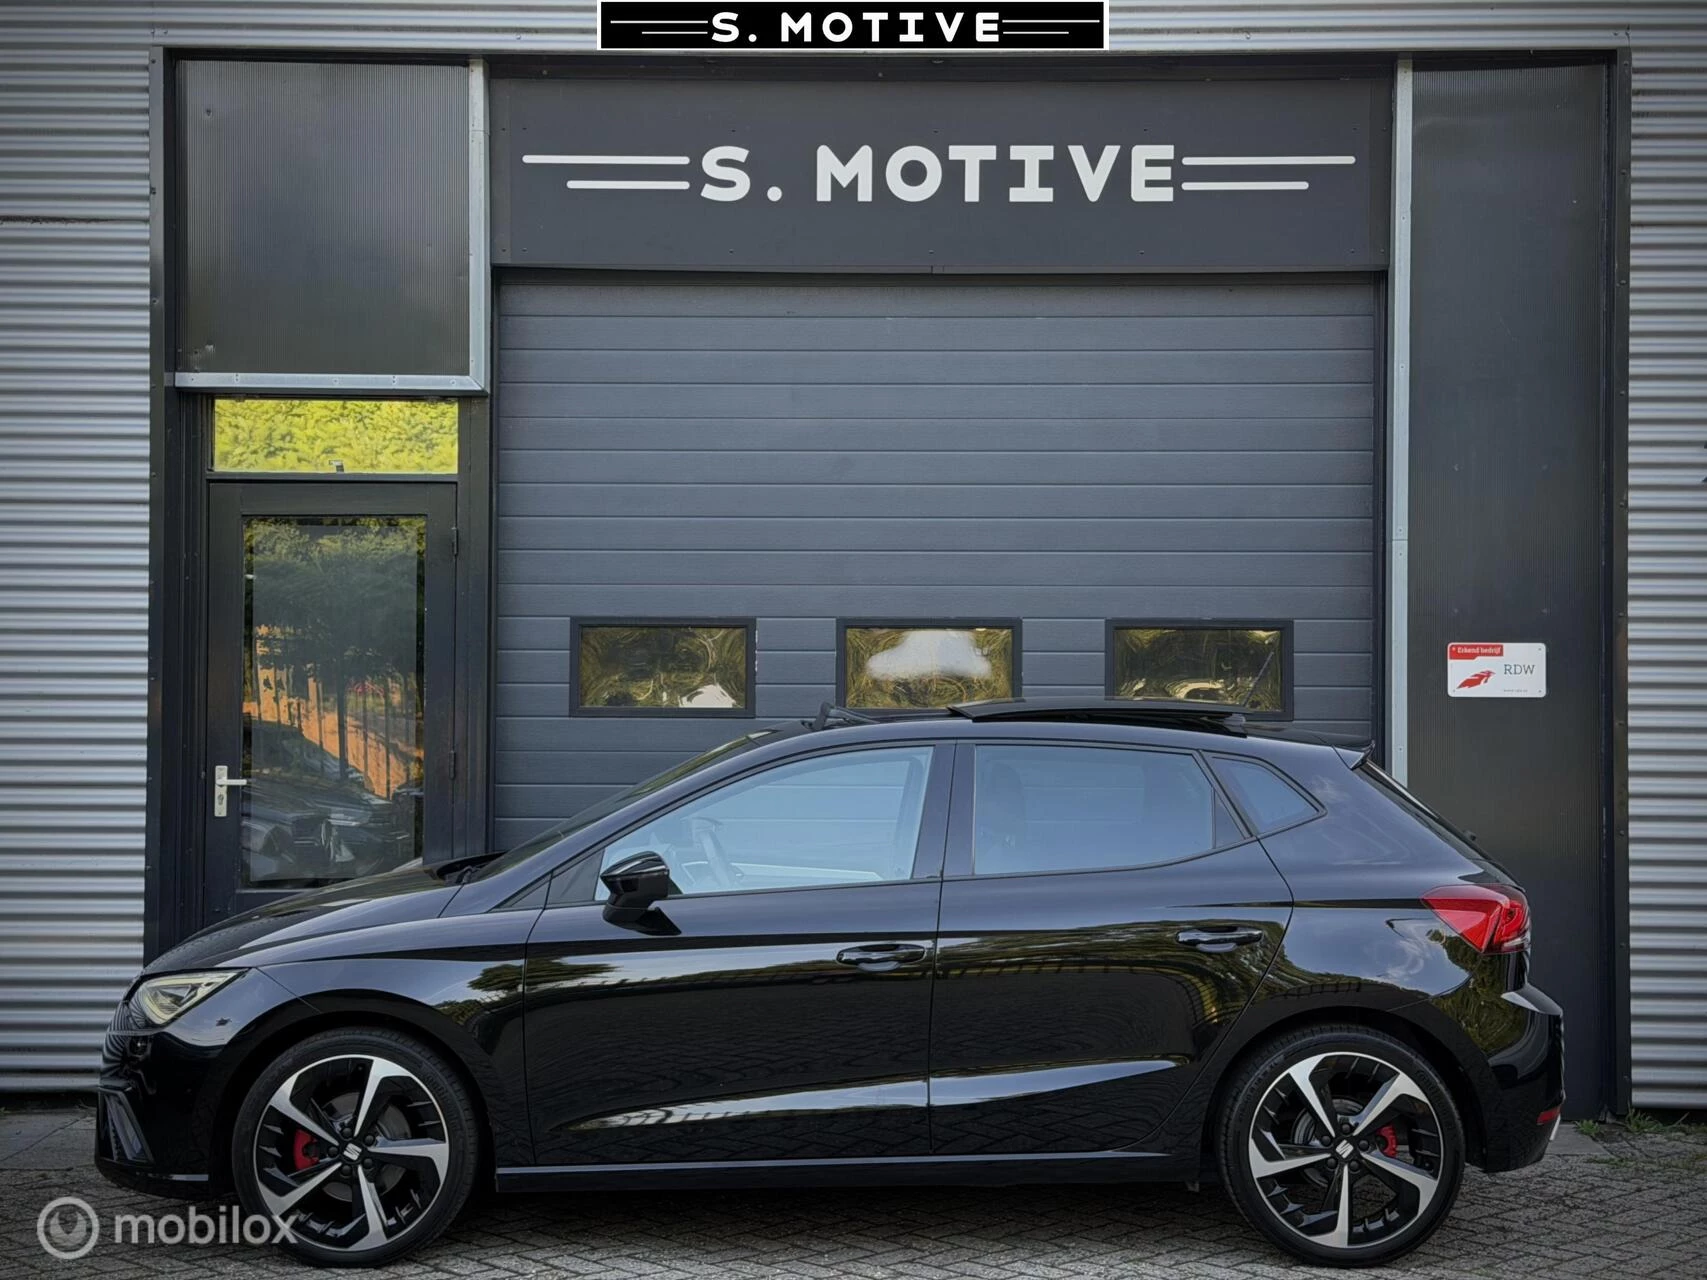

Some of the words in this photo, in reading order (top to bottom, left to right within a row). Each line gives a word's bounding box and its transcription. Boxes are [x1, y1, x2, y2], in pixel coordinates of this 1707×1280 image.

[700, 145, 783, 203] S.
[816, 144, 1175, 203] MOTIVE
[1503, 664, 1536, 675] RDW
